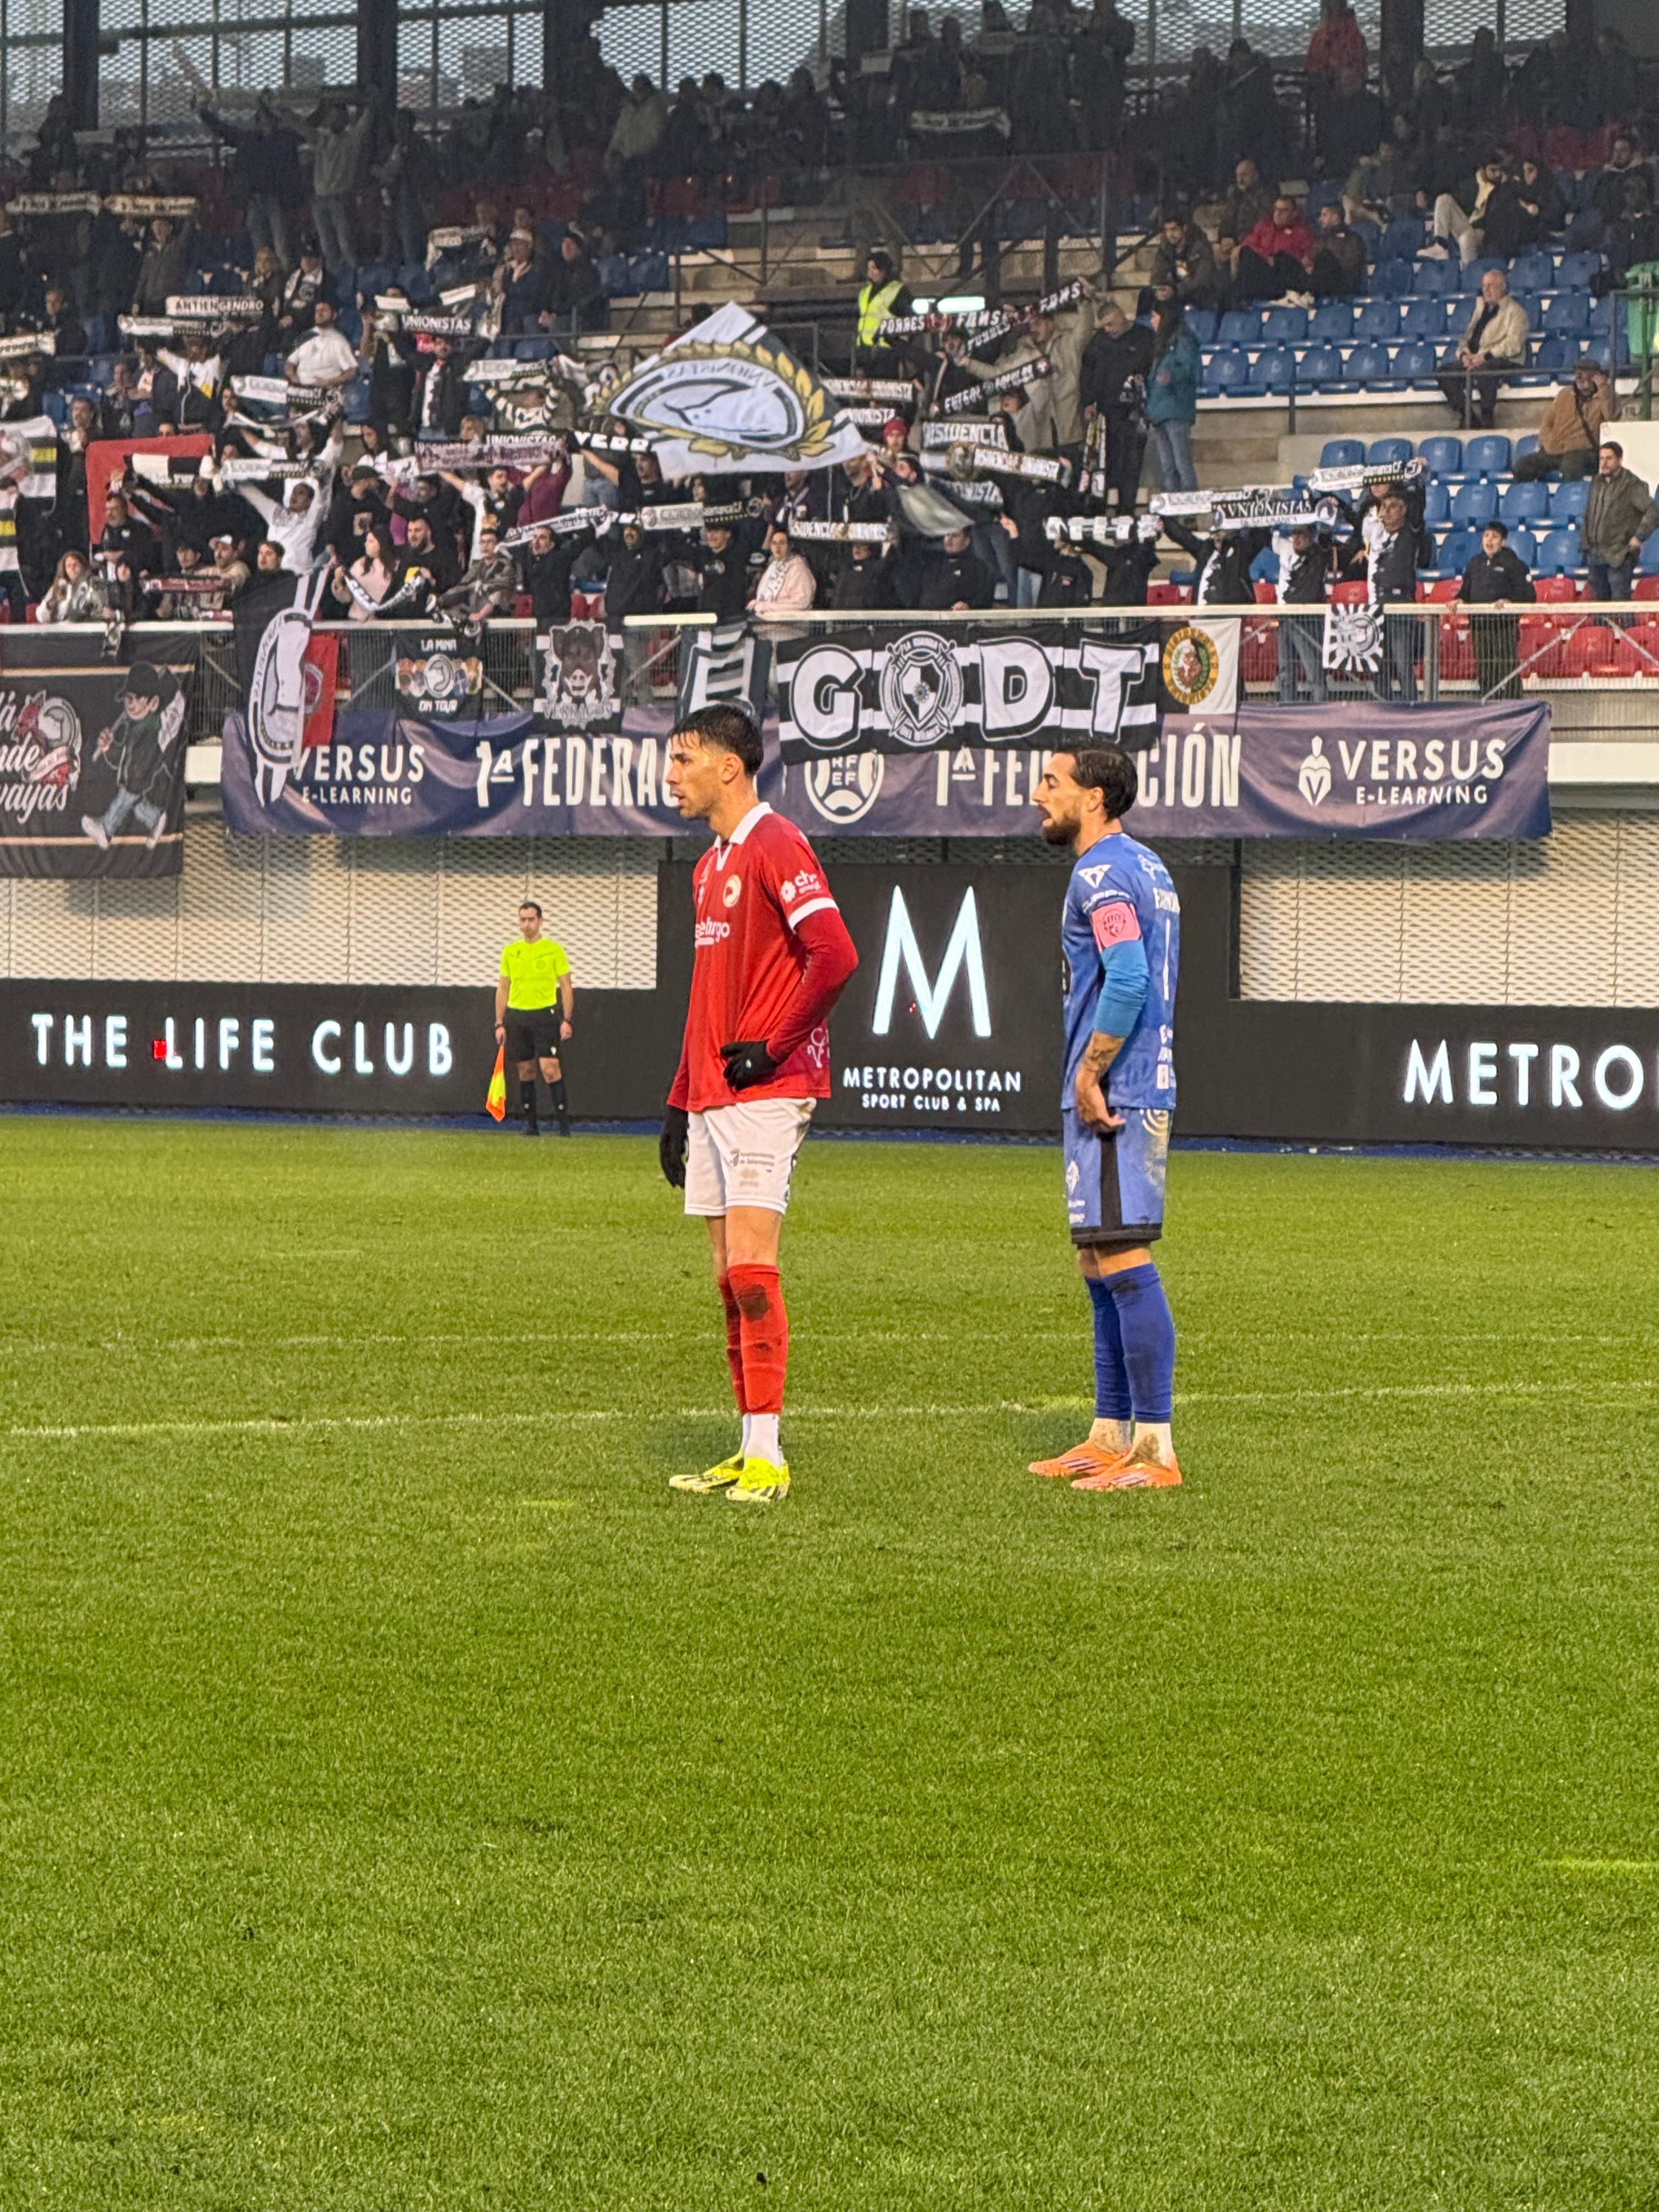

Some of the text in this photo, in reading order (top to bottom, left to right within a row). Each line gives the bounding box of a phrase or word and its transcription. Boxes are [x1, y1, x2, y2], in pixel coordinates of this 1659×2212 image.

[402, 314, 471, 330] UNIONISTAS
[923, 421, 1009, 452] DISIDENCIA
[436, 700, 458, 713] TOUR
[1338, 738, 1506, 781] VERSUS
[302, 786, 411, 805] E-LEARNING
[1357, 785, 1488, 805] E-LEARNING
[873, 885, 992, 1039] M
[31, 1013, 453, 1075] THE LIFE CLUB
[843, 1066, 1022, 1092] METROPOLITAN
[1403, 1039, 1659, 1111] METRO
[861, 1093, 1001, 1113] SPORT CLUB & SPA
